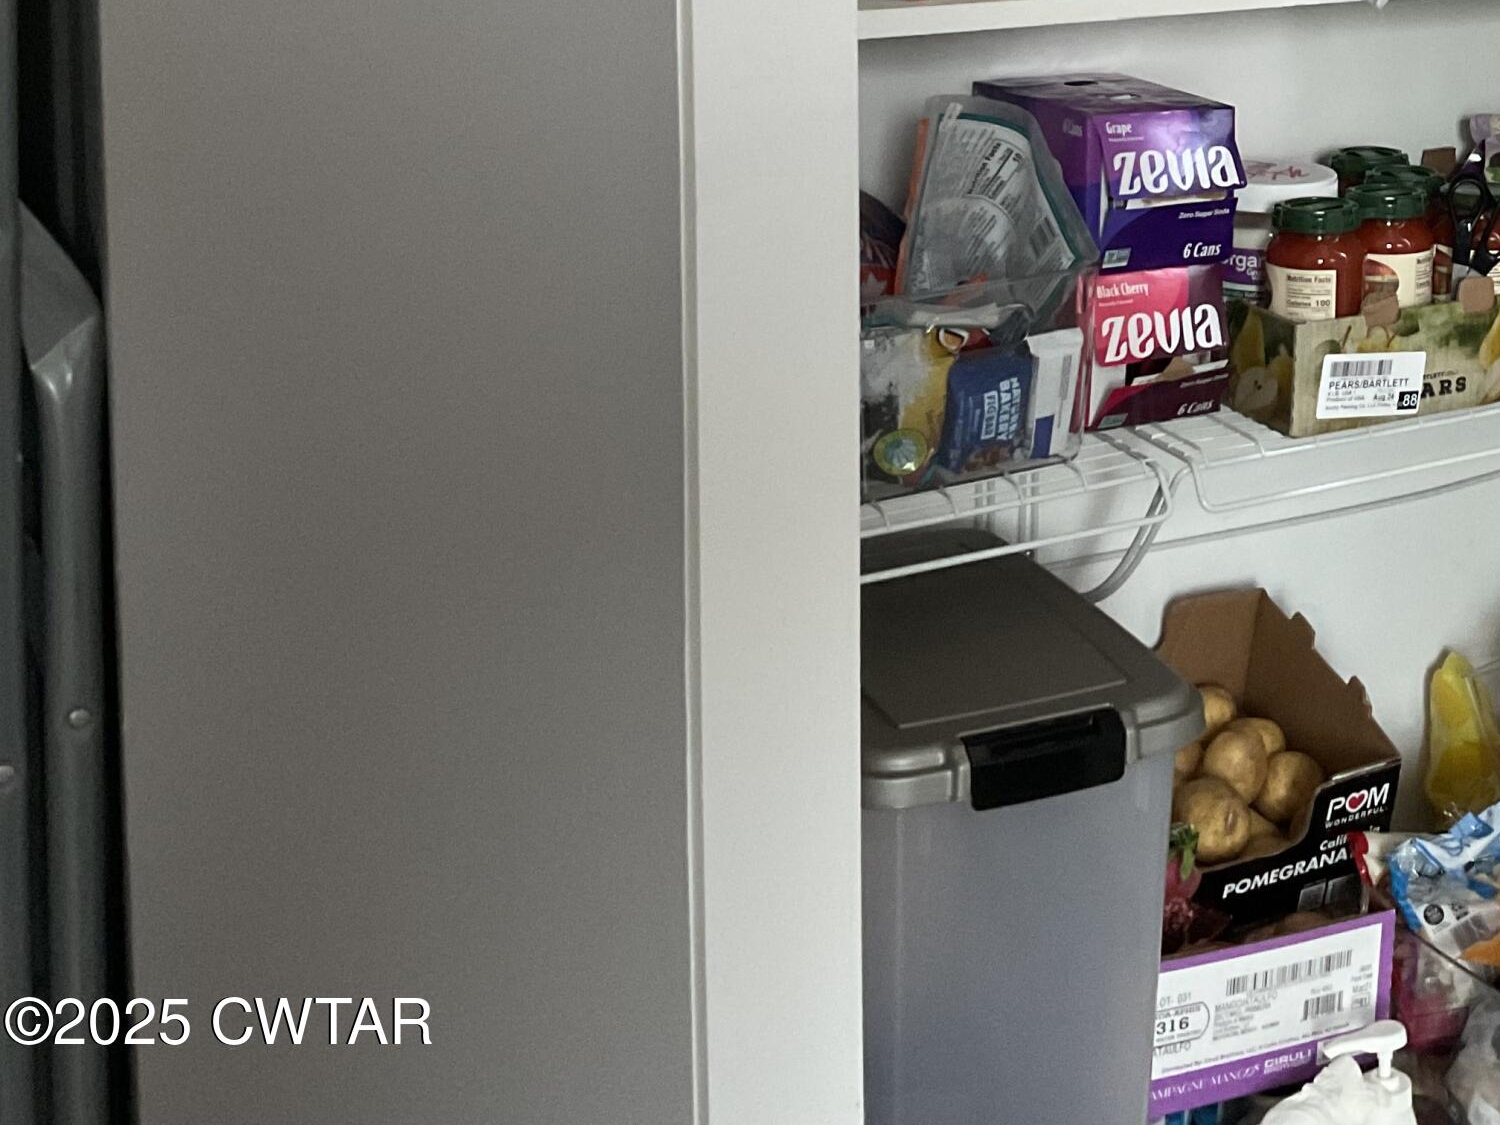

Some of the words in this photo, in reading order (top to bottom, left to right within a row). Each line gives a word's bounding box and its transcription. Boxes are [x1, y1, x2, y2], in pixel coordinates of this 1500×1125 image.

[1105, 121, 1132, 136] Grape
[1112, 145, 1241, 196] zevia
[1183, 243, 1192, 259] 6
[1193, 241, 1222, 257] Cans
[1096, 284, 1121, 299] Black
[1121, 282, 1149, 297] Cherry
[1315, 299, 1331, 307] 100
[1101, 303, 1223, 364] zevia
[1328, 377, 1410, 390] PEARS/BARTLETT
[1187, 399, 1214, 414] Cans
[1402, 393, 1418, 407] 88
[1326, 782, 1390, 821] POM
[1325, 807, 1385, 829] WONDERFUL
[1222, 847, 1348, 899] POMEGRANA
[1156, 1017, 1190, 1035] 316
[1264, 1049, 1312, 1069] CIRULI
